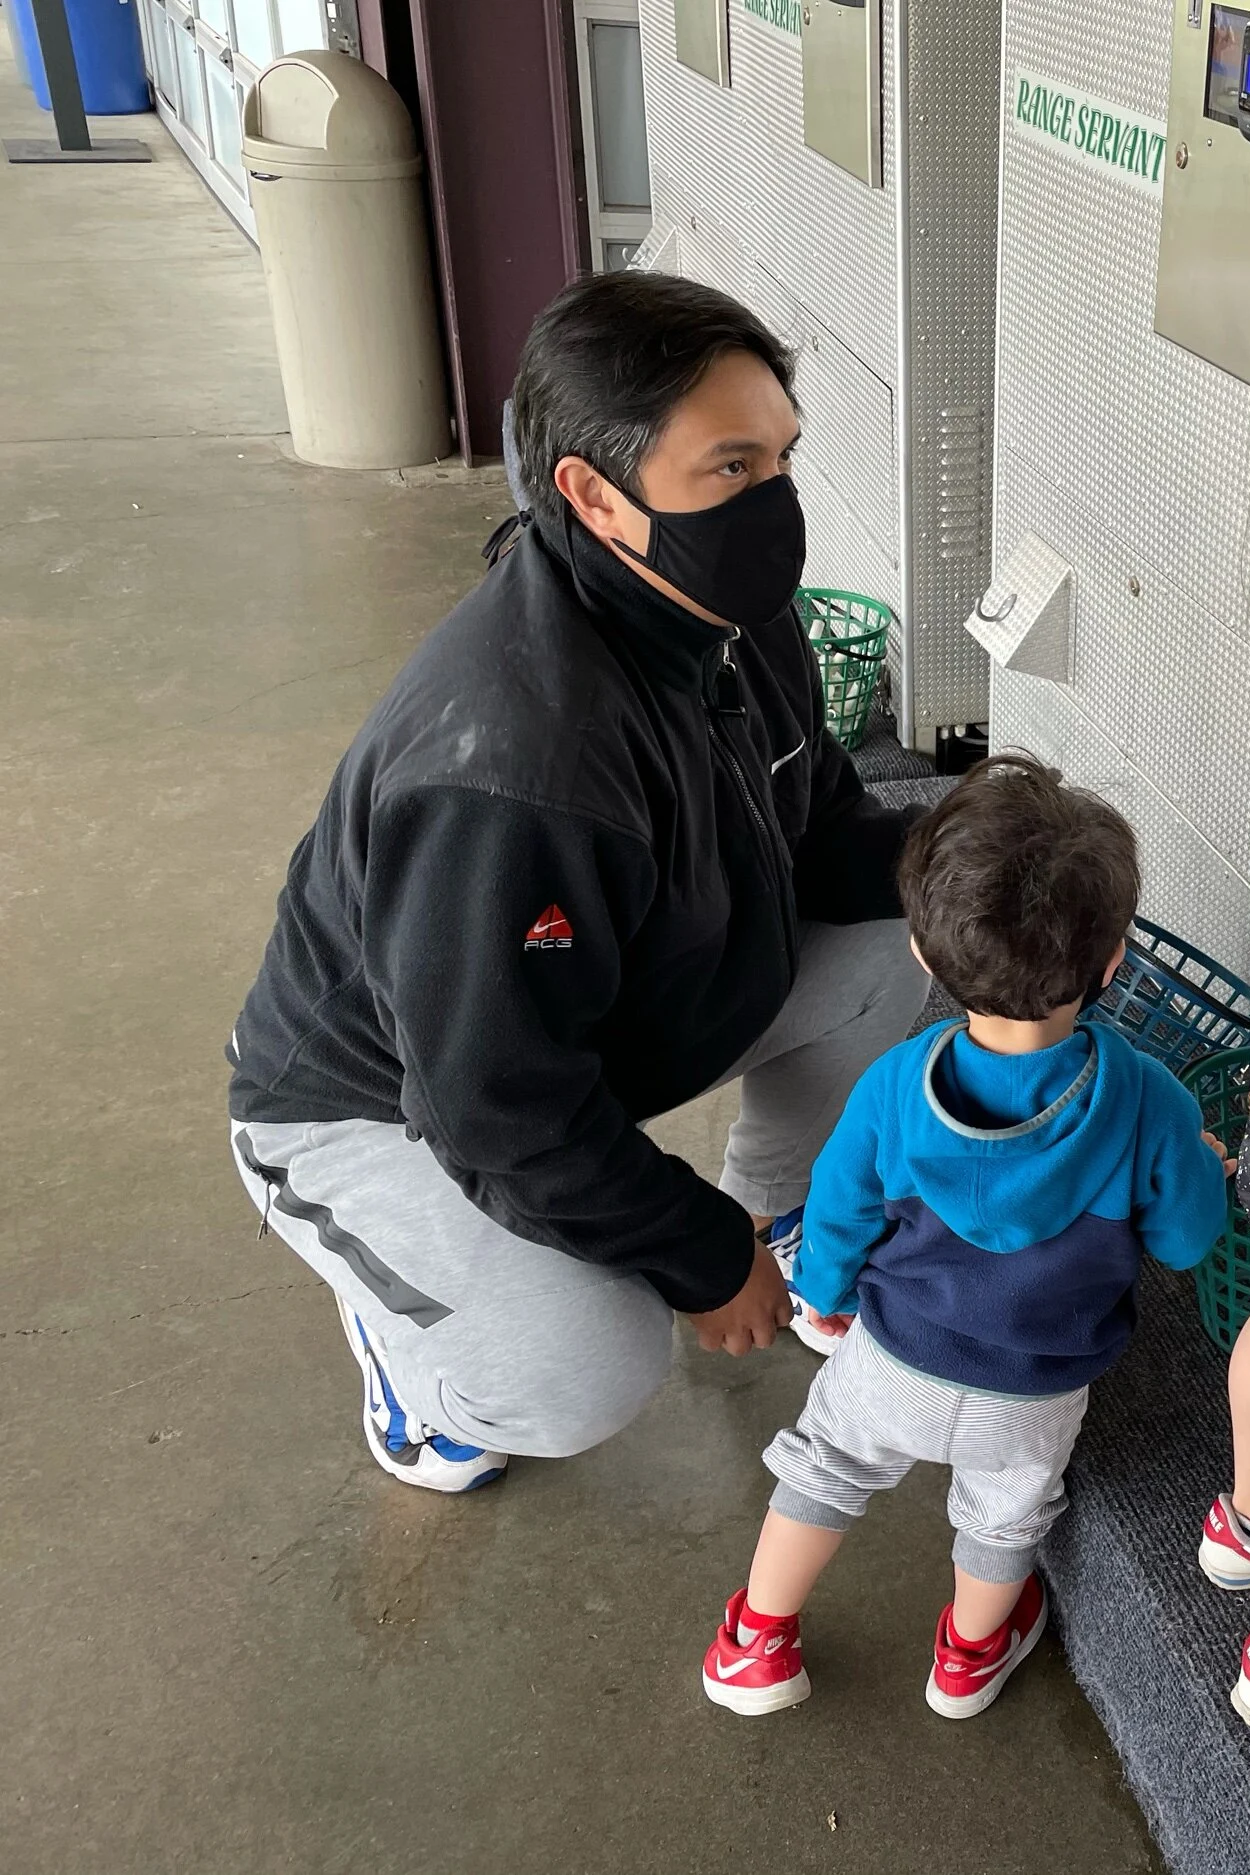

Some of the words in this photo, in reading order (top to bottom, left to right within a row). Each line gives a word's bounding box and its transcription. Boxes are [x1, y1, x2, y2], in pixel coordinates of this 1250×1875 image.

[1017, 78, 1075, 144] RANGE
[1075, 103, 1167, 183] SERVANT
[524, 938, 573, 951] ACG
[1209, 1504, 1225, 1534] NIKE
